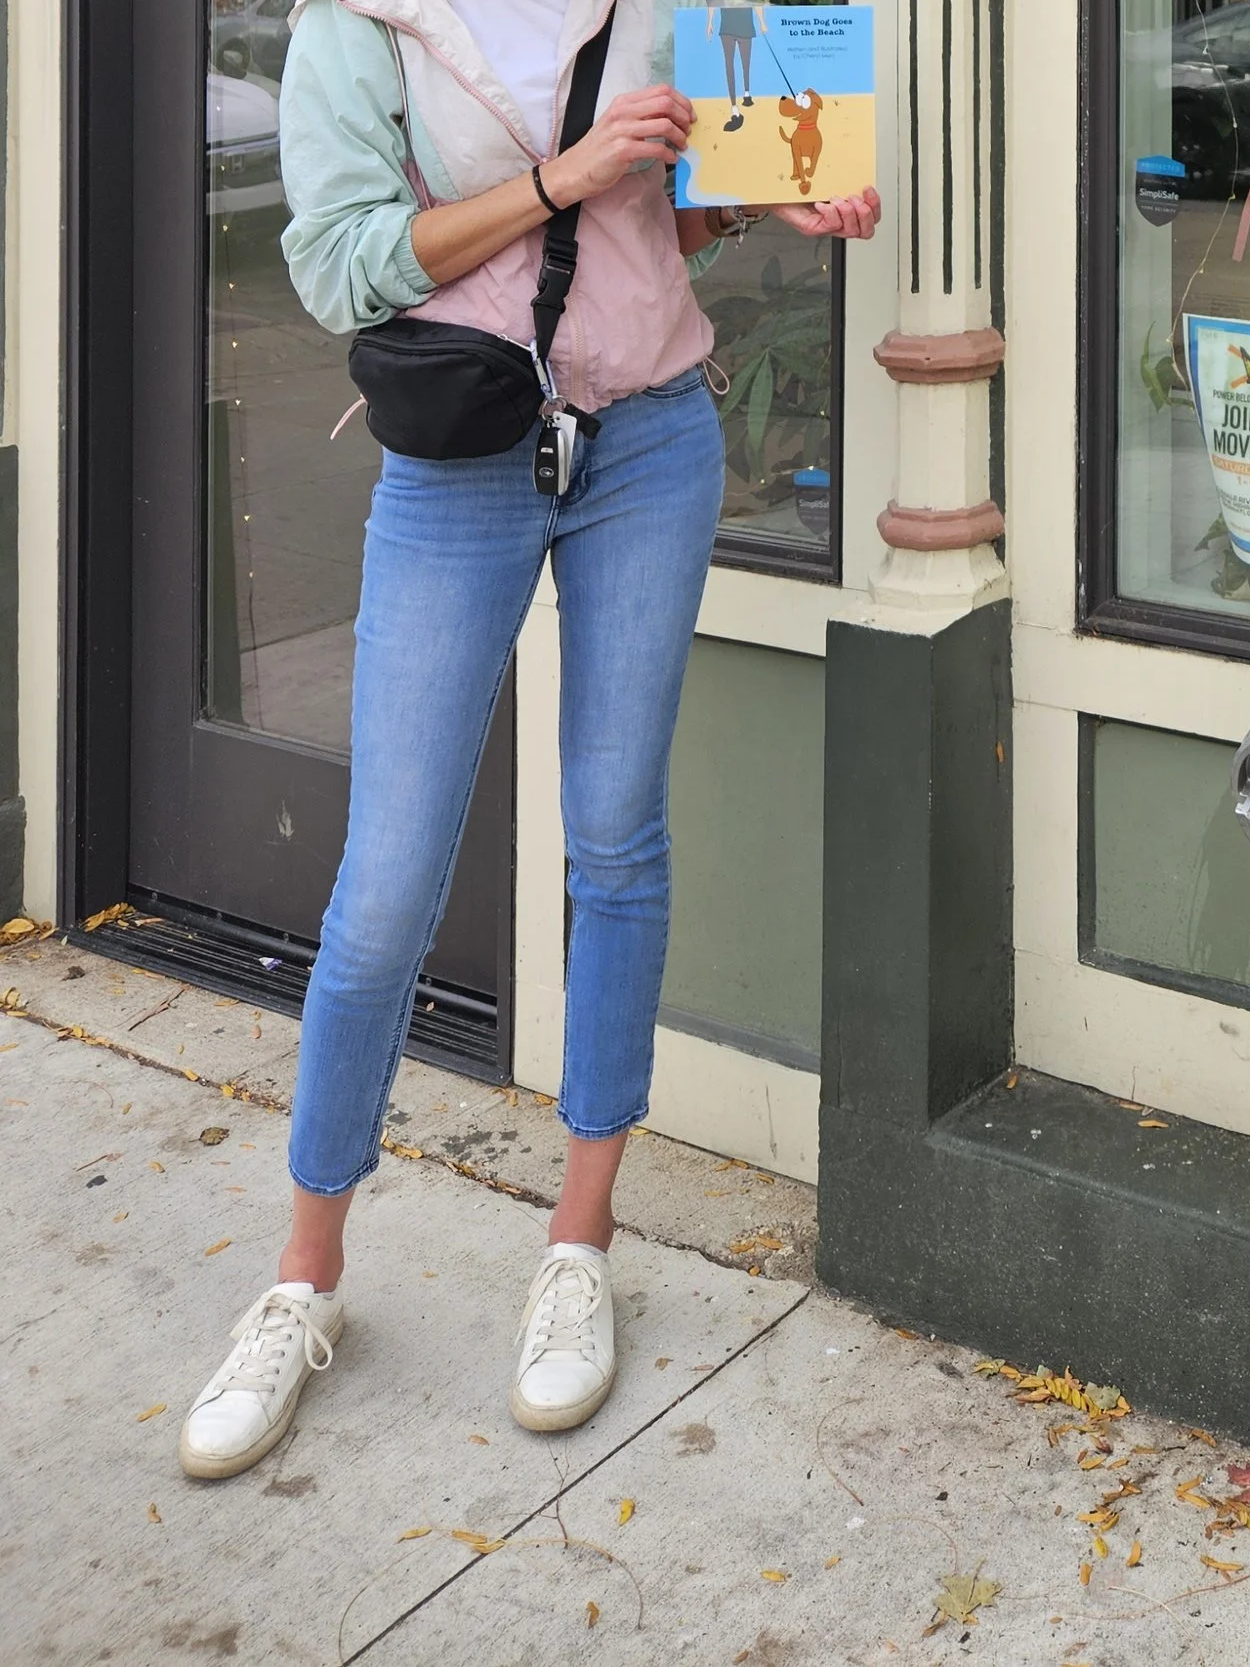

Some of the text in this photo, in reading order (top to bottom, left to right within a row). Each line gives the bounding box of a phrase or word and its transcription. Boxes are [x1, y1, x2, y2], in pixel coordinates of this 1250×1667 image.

[813, 18, 830, 26] Dog
[1139, 188, 1179, 200] SimpliSafe
[1213, 389, 1235, 401] POWER
